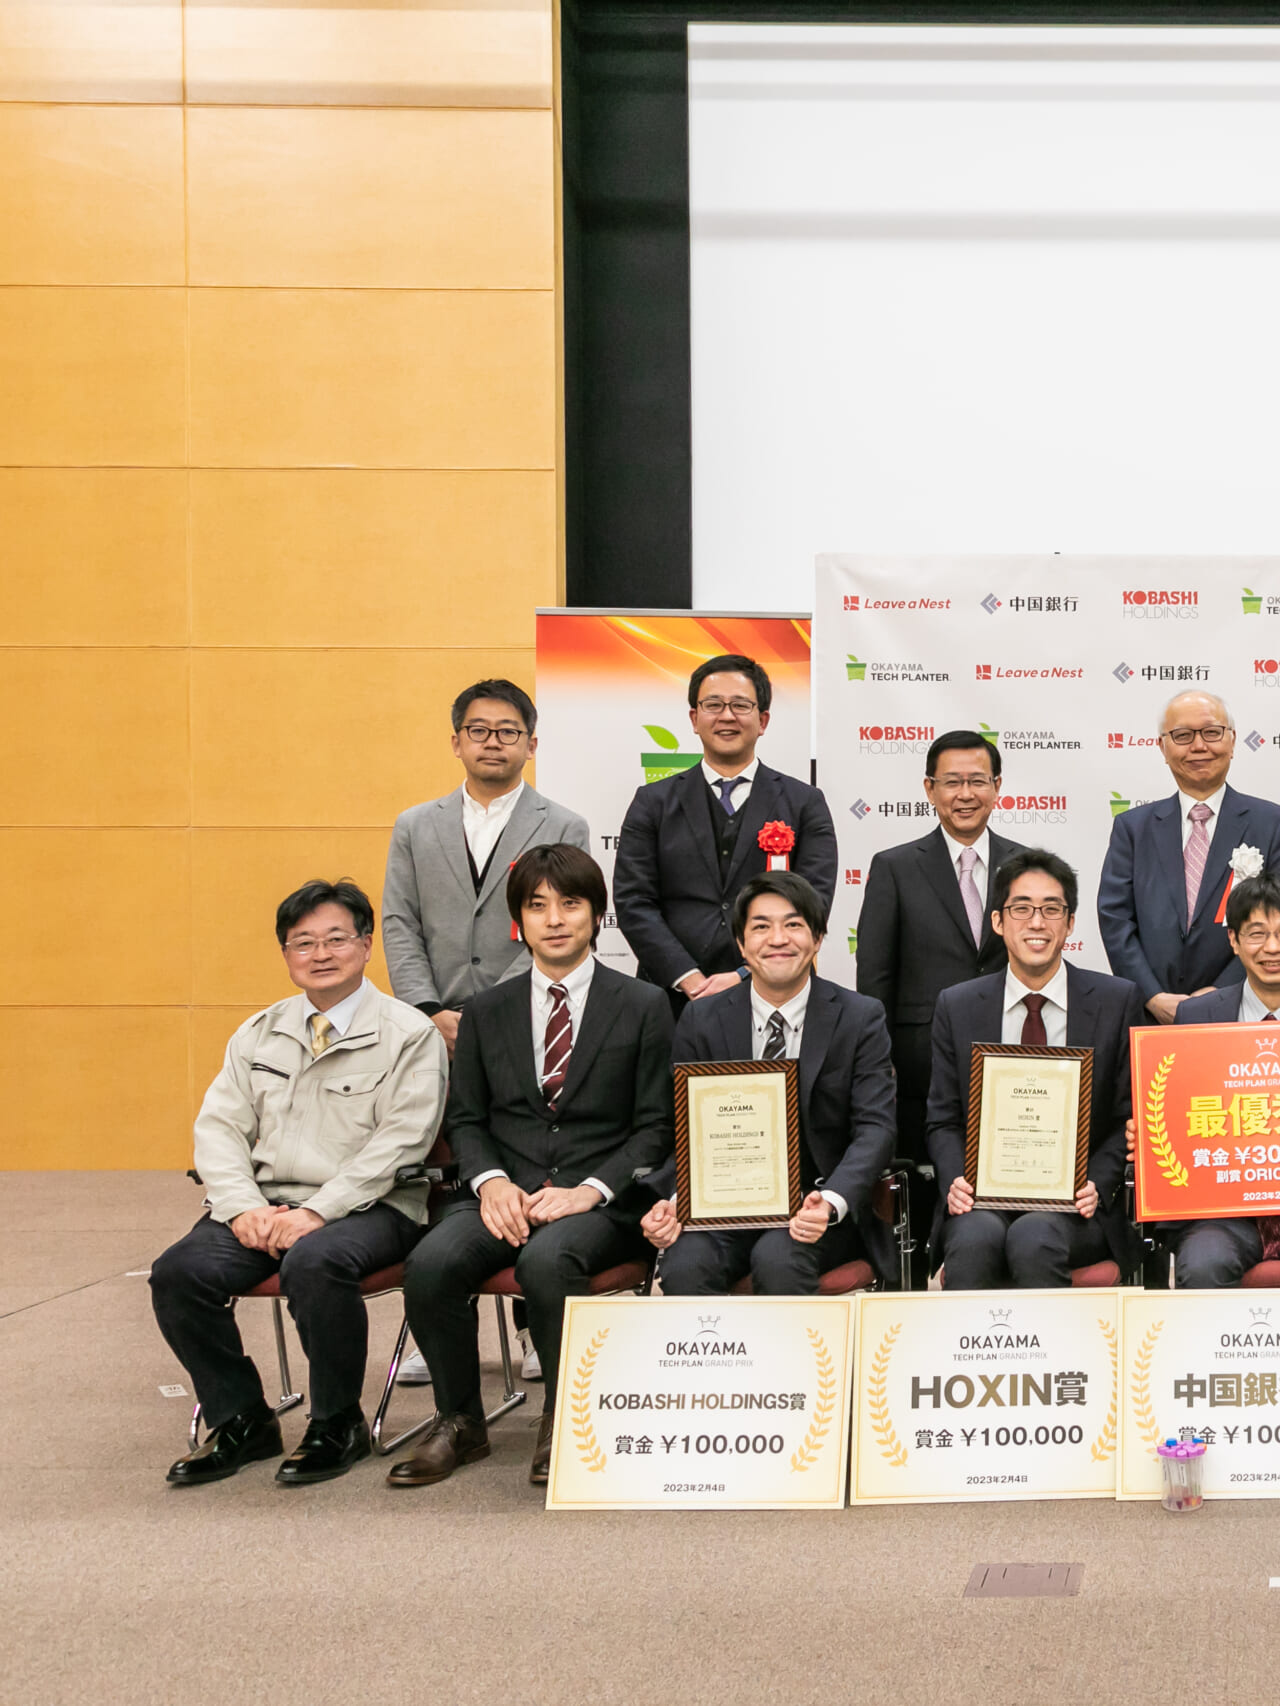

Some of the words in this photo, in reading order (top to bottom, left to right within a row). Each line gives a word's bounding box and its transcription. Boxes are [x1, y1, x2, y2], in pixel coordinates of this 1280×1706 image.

[865, 599, 905, 609] Leave
[908, 601, 917, 609] a
[919, 599, 951, 609] Nest
[1010, 597, 1077, 611] 中国銀行
[1123, 591, 1198, 605] KOBASHI
[1123, 606, 1199, 619] HOLDINGS
[871, 663, 923, 671] OKAYAMA
[996, 667, 1038, 677] Leave
[1051, 667, 1083, 678] Nest
[1142, 665, 1209, 680] 中国銀行
[859, 726, 934, 740] KOBASHI
[1004, 731, 1055, 739] OKAYAMA
[859, 741, 930, 754] HOLDING
[1003, 741, 1030, 749] TECH
[992, 811, 1067, 824] HOLDINGS
[1063, 940, 1083, 951] est
[1224, 1080, 1244, 1088] TECH
[1245, 1080, 1266, 1088] PLAN
[1193, 1148, 1229, 1167] 賞金
[1216, 1169, 1241, 1183] 副賞
[666, 1342, 746, 1355] OKAYAMA
[960, 1335, 1040, 1349] OKAYAMA
[1000, 1352, 1027, 1360] GRAND
[911, 1371, 1088, 1409] HOXIN賞
[599, 1394, 685, 1409] KOBASHI
[692, 1393, 806, 1410] HOLDINGS賞
[915, 1429, 953, 1448] 賞金
[961, 1425, 1083, 1446] ¥100,000
[615, 1435, 653, 1454] 賞金
[661, 1435, 784, 1454] ¥100,000
[967, 1475, 1027, 1484] 2023年2月4日
[664, 1484, 725, 1492] 2023年2月4日
